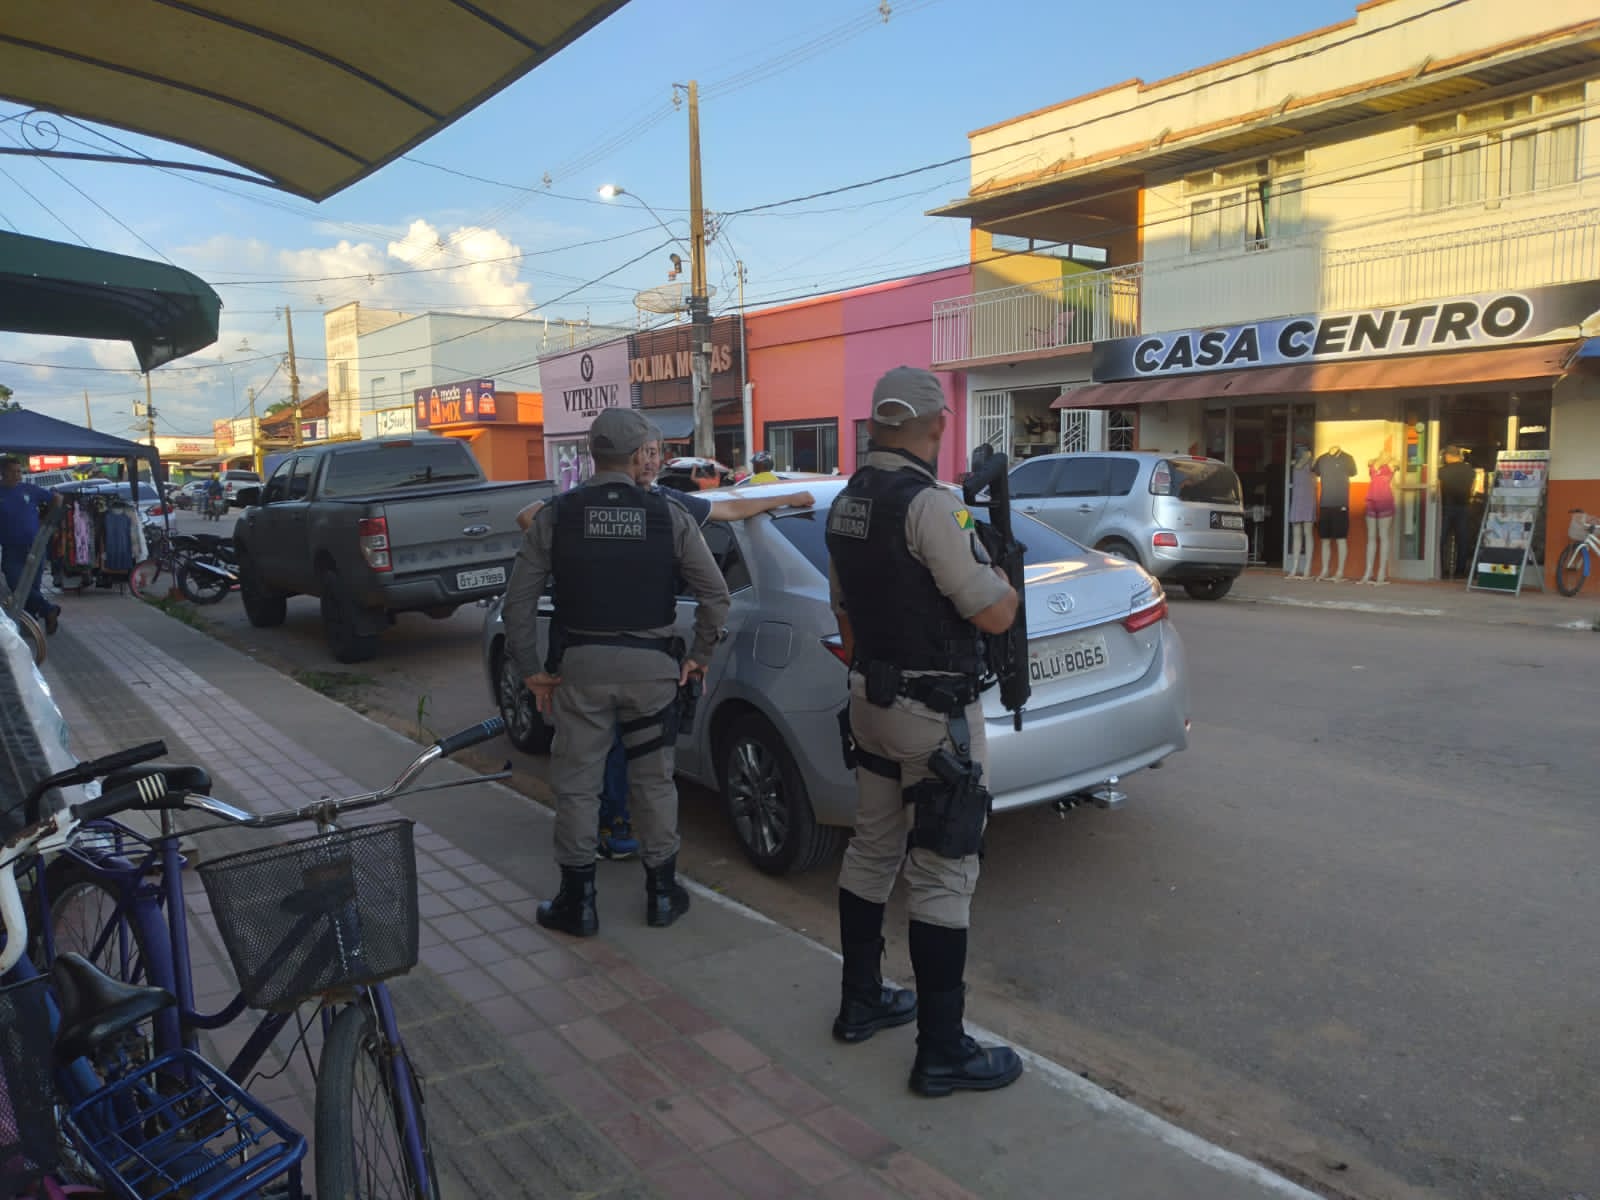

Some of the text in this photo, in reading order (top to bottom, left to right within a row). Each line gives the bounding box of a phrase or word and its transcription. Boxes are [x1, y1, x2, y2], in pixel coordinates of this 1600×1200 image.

[1134, 294, 1533, 373] CASA CENTRO
[629, 354, 675, 384] JOLINA
[441, 401, 461, 422] MIX
[563, 384, 618, 412] VITRINE
[589, 523, 642, 537] MILITAR
